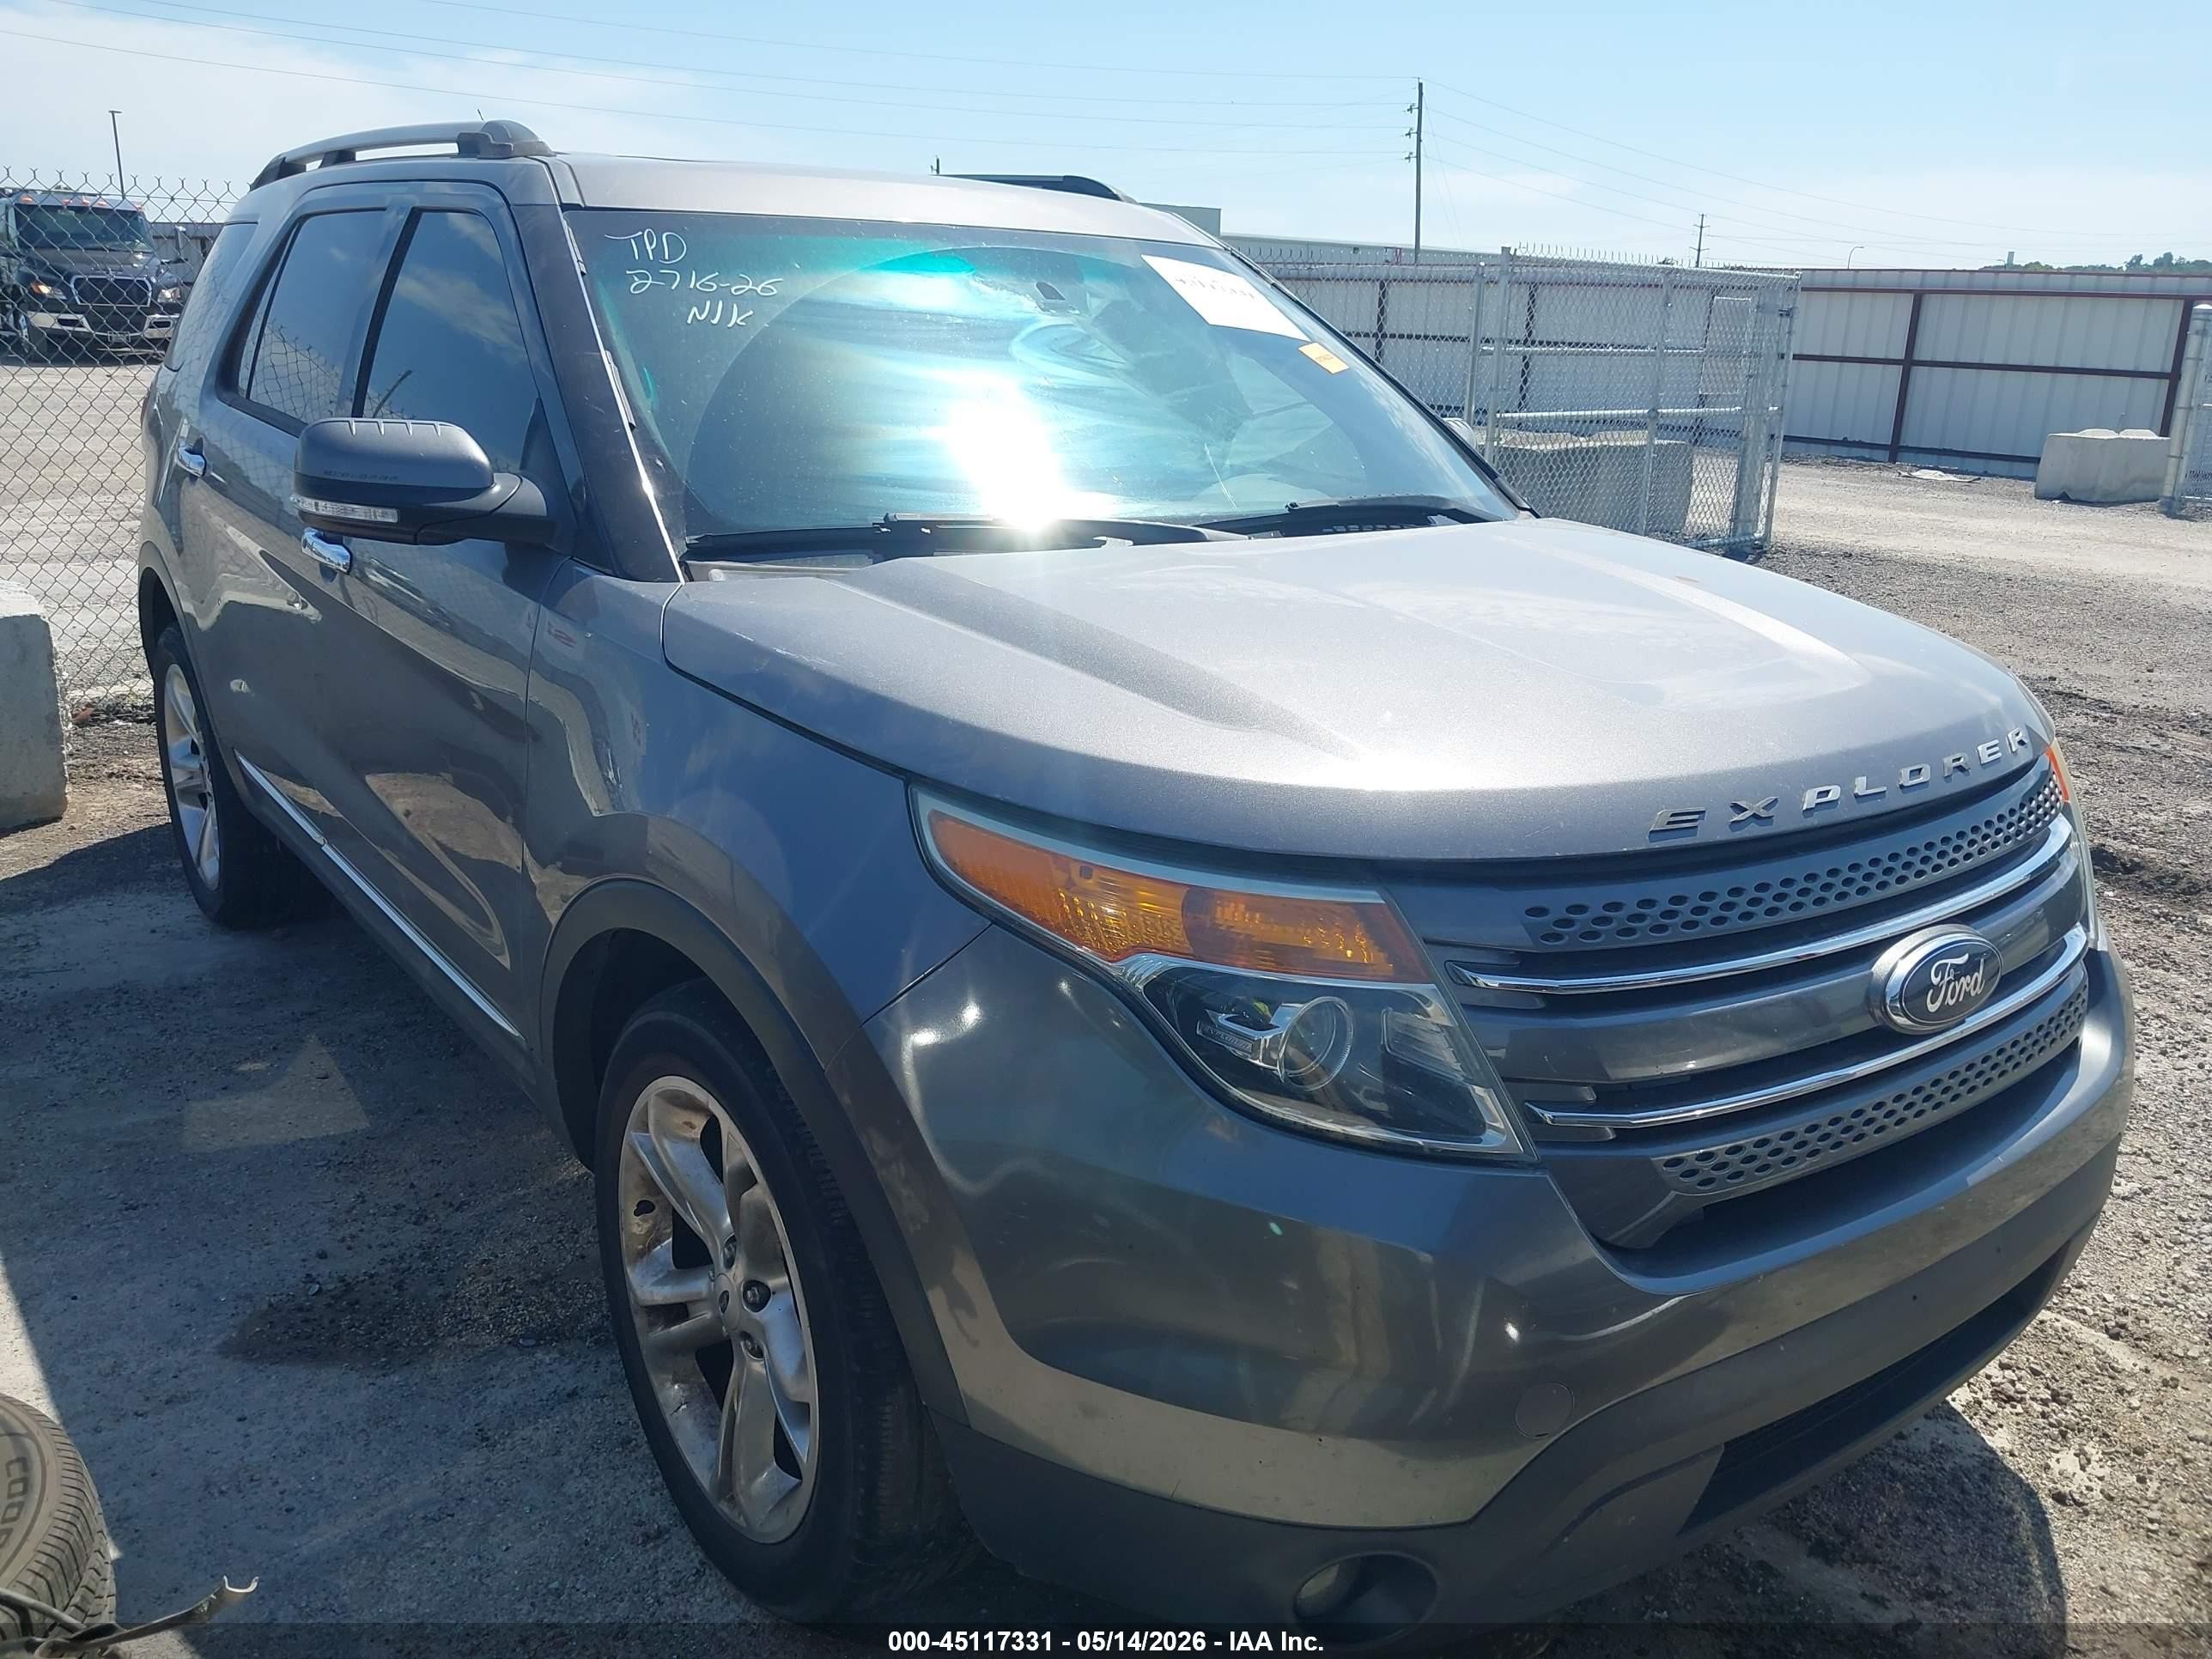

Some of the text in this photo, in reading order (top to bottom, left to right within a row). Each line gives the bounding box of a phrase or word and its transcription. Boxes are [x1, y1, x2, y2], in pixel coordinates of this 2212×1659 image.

[604, 228, 688, 264] TPD
[1648, 726, 2029, 834] EXPLORER
[1926, 952, 1986, 1013] Ford
